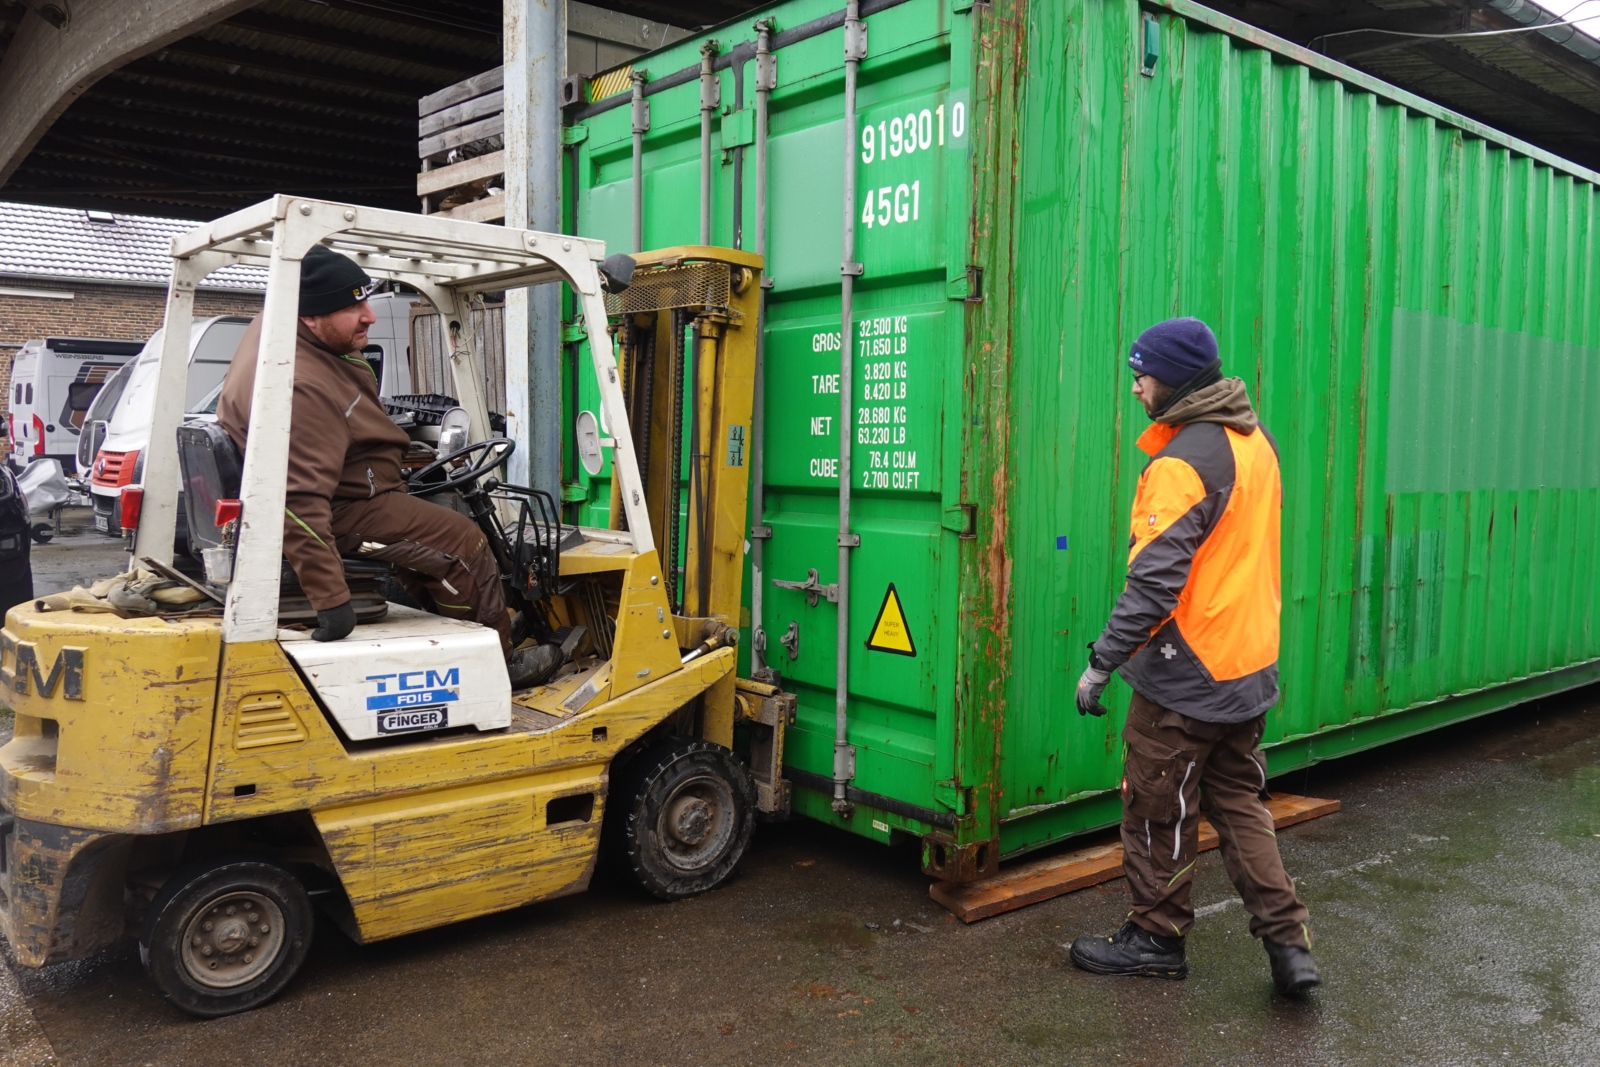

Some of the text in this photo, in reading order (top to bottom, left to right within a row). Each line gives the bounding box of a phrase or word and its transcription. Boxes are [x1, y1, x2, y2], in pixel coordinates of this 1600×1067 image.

[861, 180, 920, 228] 45G1
[859, 316, 907, 337] 32.500 KG
[812, 332, 842, 352] GROS
[859, 337, 907, 357] 71.650 LB
[864, 361, 907, 380] 3.820 KG
[812, 374, 840, 394] TARE
[864, 382, 907, 400] 8.420 LB
[858, 406, 907, 424] 28.680 KG
[811, 417, 832, 435] NET
[857, 427, 906, 444] 63.230 LB
[810, 459, 838, 477] CUBE
[869, 451, 916, 468] 76.4 CU.M
[863, 471, 919, 489] 2.700 CU.FT
[366, 668, 459, 693] TCM
[397, 692, 433, 705] FD15
[388, 712, 438, 728] FINGER
